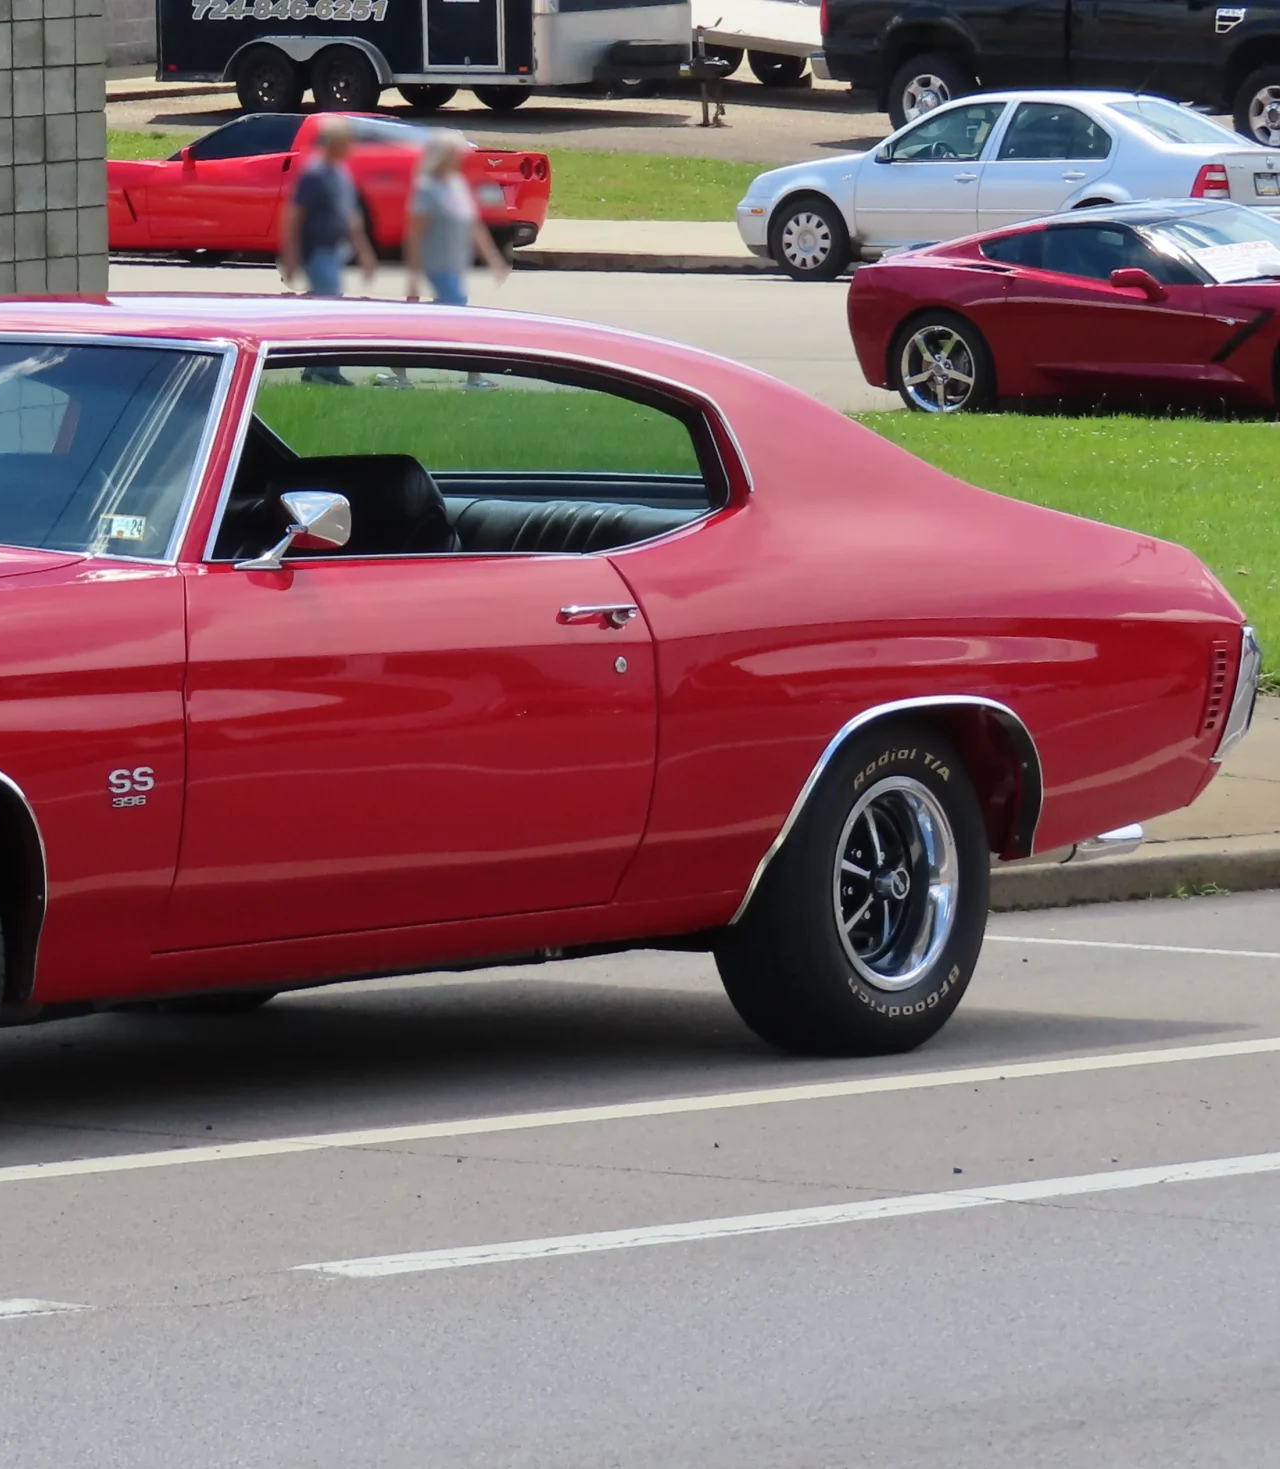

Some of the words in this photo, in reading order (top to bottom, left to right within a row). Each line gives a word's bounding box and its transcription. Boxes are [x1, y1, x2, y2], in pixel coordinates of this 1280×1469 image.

[191, 0, 388, 21] 724-846-6251
[108, 766, 155, 794] SS
[853, 748, 917, 791] Radial
[923, 752, 951, 781] T/A
[112, 795, 147, 808] 396
[848, 963, 961, 1019] BFGoodrich
